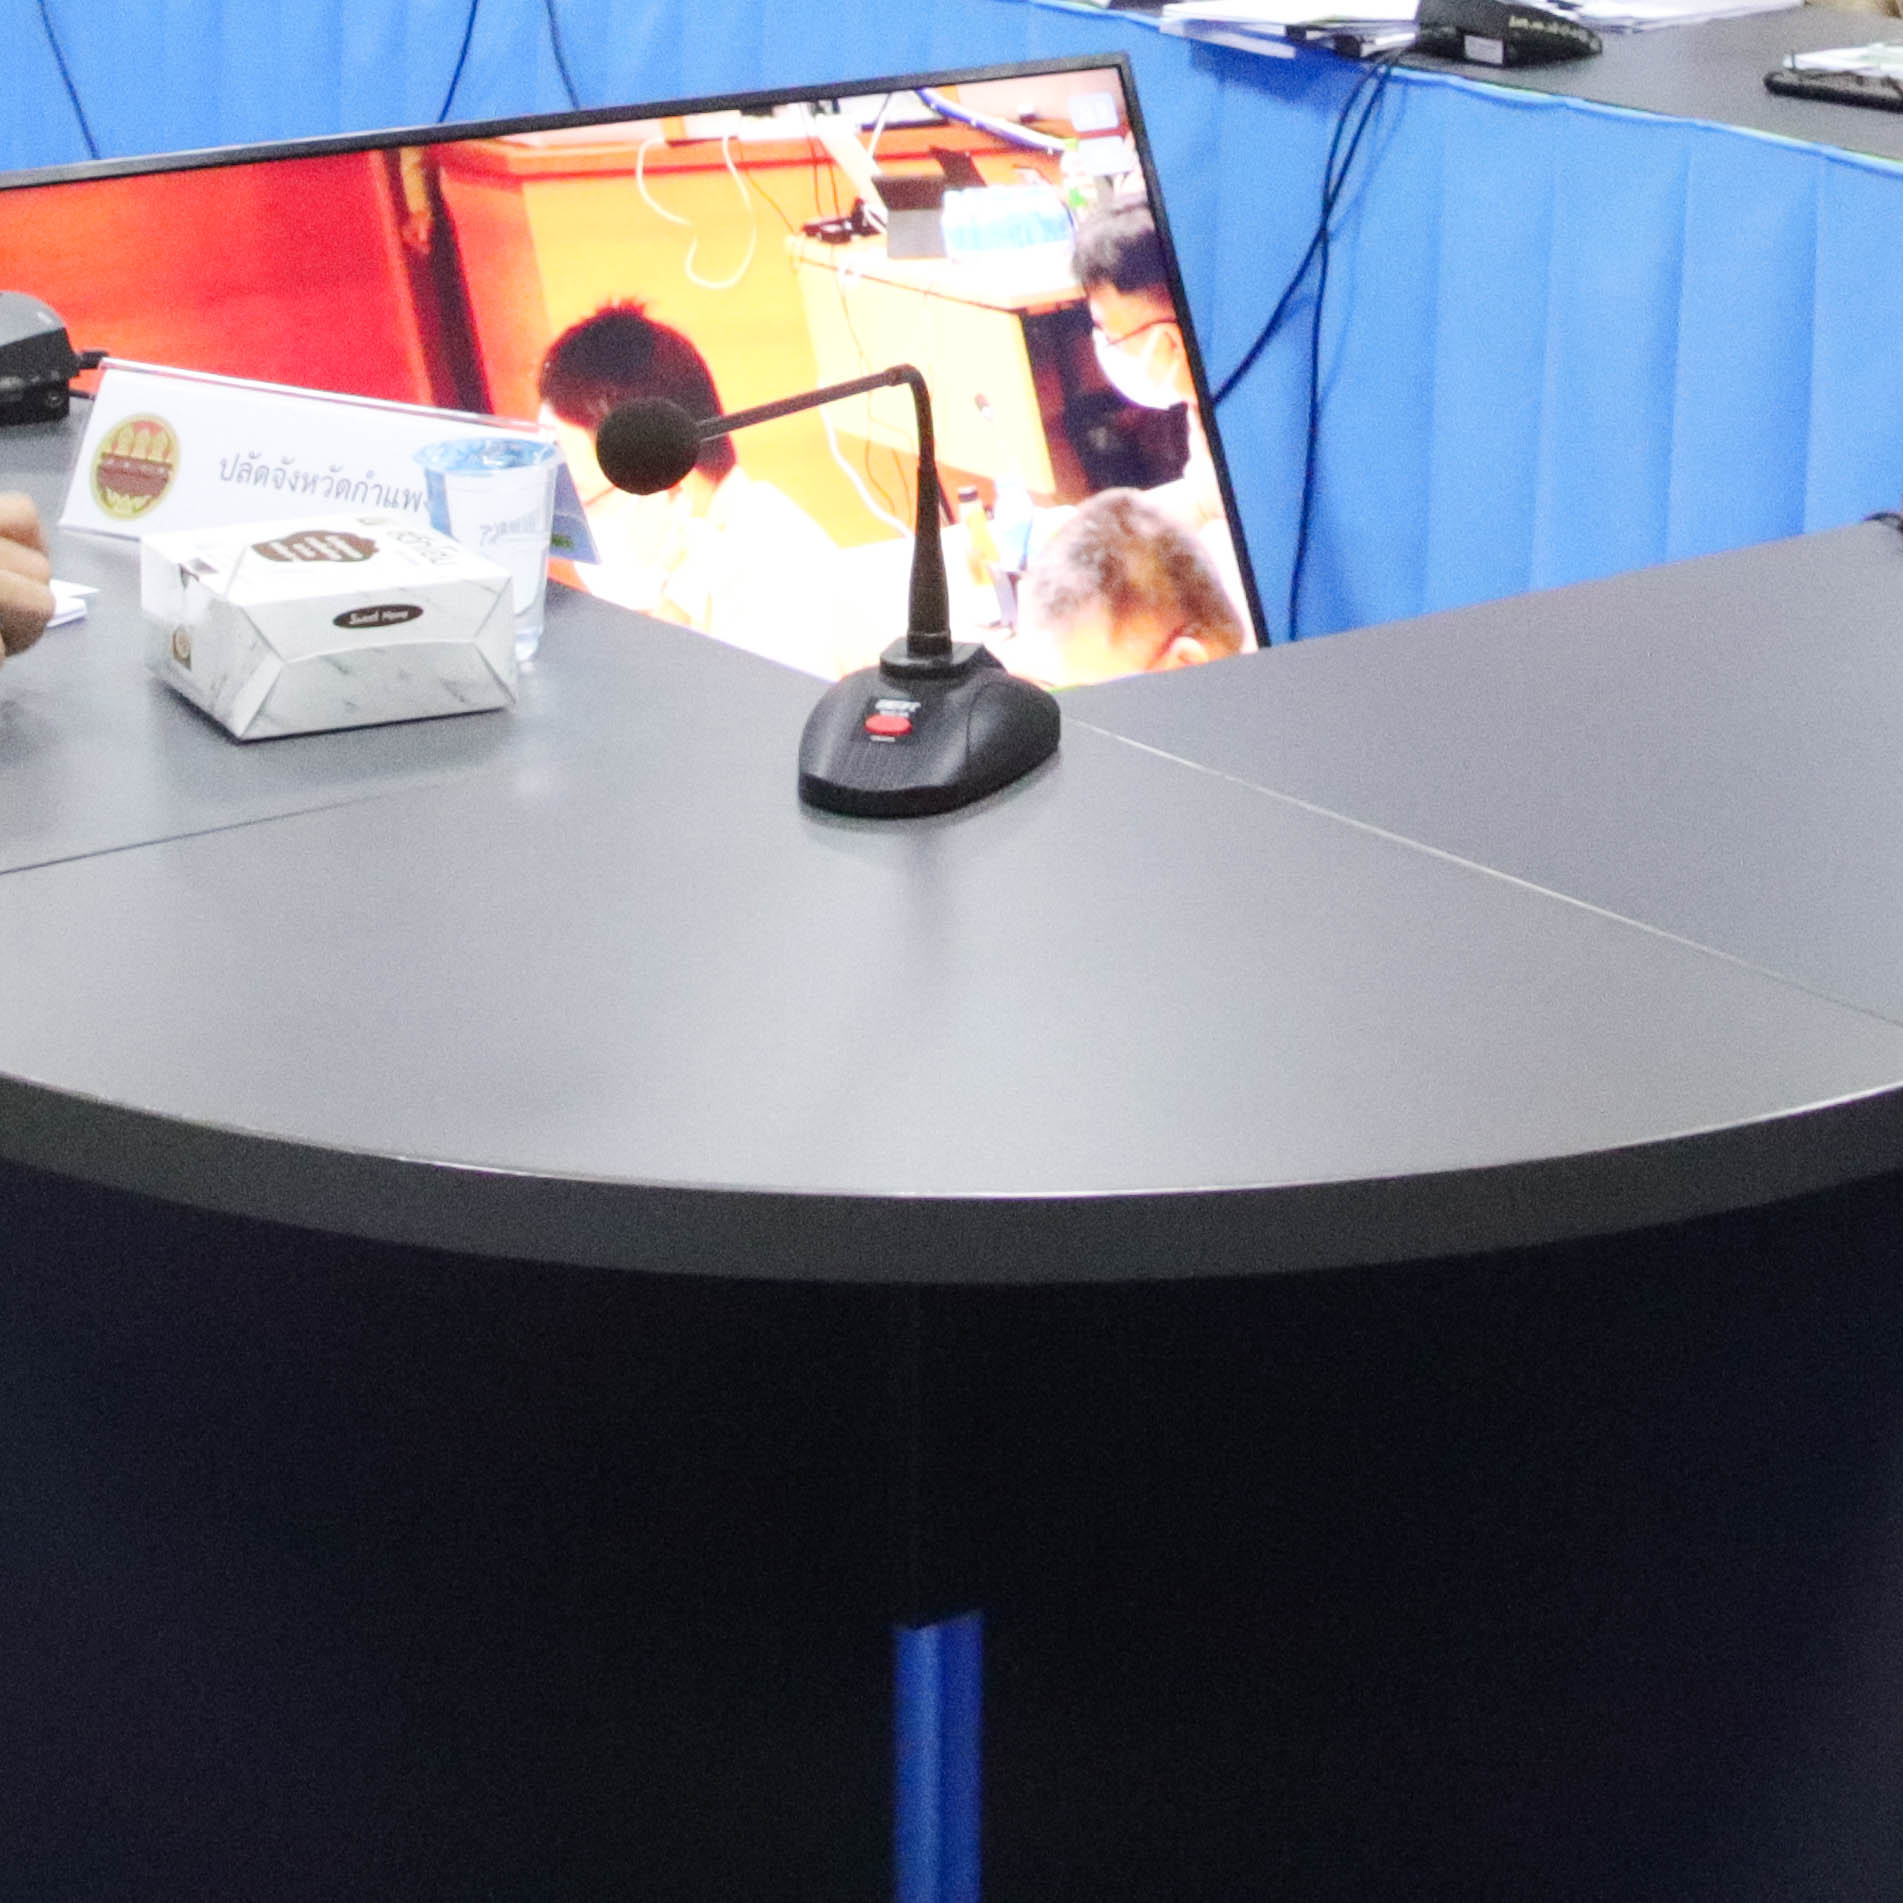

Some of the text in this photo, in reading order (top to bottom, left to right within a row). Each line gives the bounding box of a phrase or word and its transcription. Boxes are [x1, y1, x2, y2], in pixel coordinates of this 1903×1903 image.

[218, 450, 430, 513] ปลัดจังหวัดกำแพ
